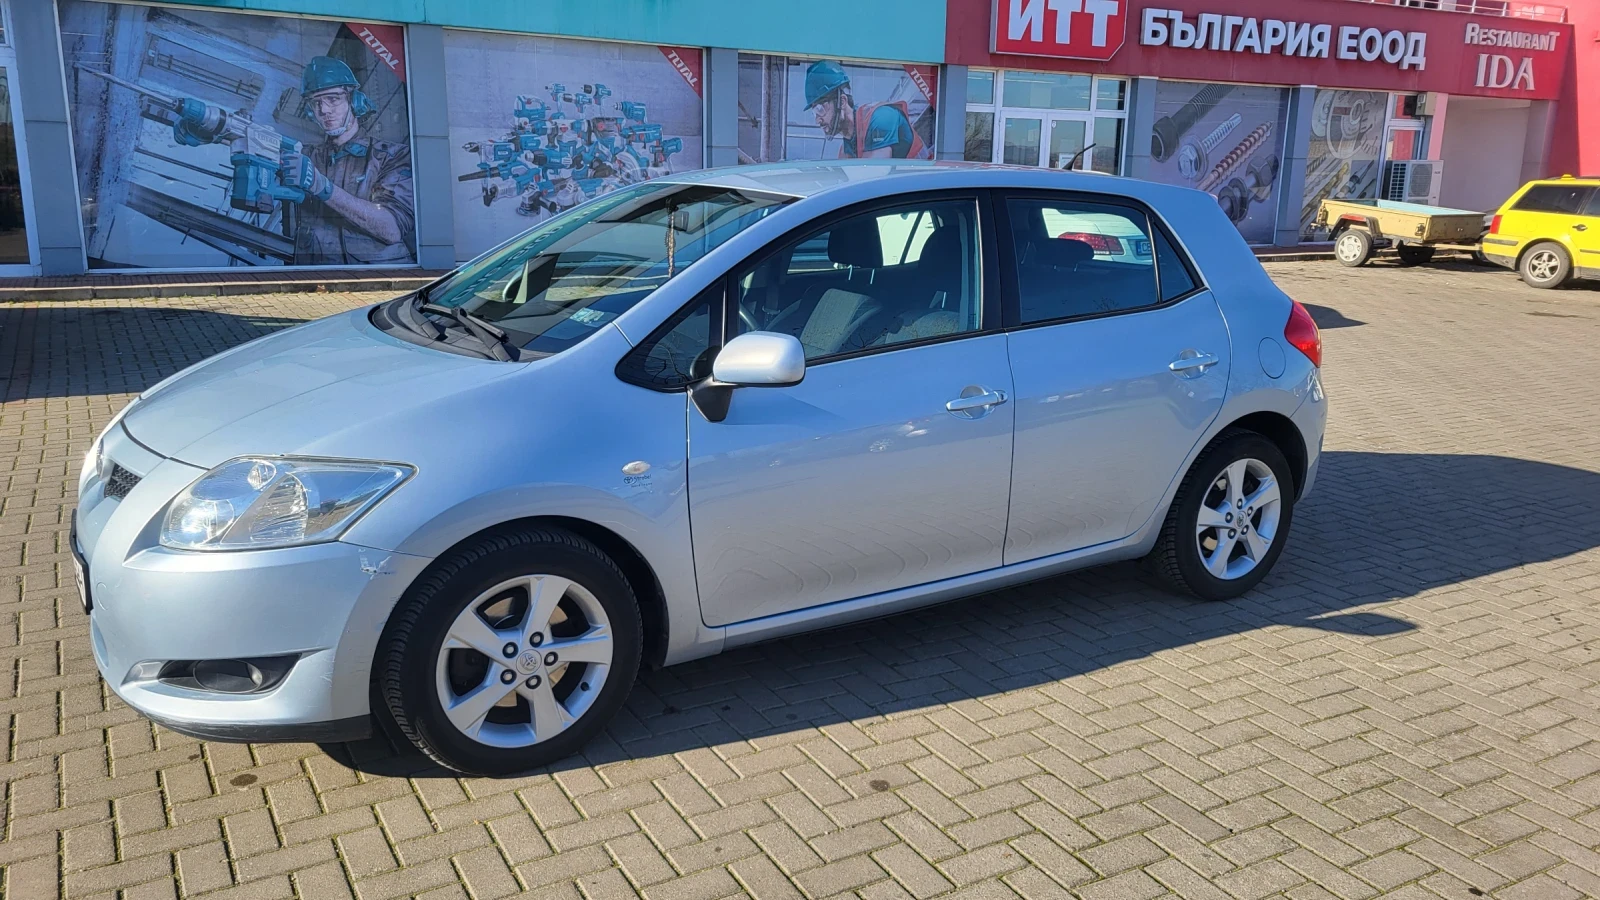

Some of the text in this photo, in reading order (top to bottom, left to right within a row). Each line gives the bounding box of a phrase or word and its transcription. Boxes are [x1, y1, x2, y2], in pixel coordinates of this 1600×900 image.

[1008, 0, 1119, 47] ИТТ
[1140, 8, 1427, 71] БЪЛГАРИЯ ЕООД
[1464, 22, 1560, 52] RESTAURANT
[359, 27, 399, 70] TOTAL
[668, 49, 698, 87] TOTAL
[910, 67, 933, 101] TOTAL
[1475, 53, 1535, 91] IDA
